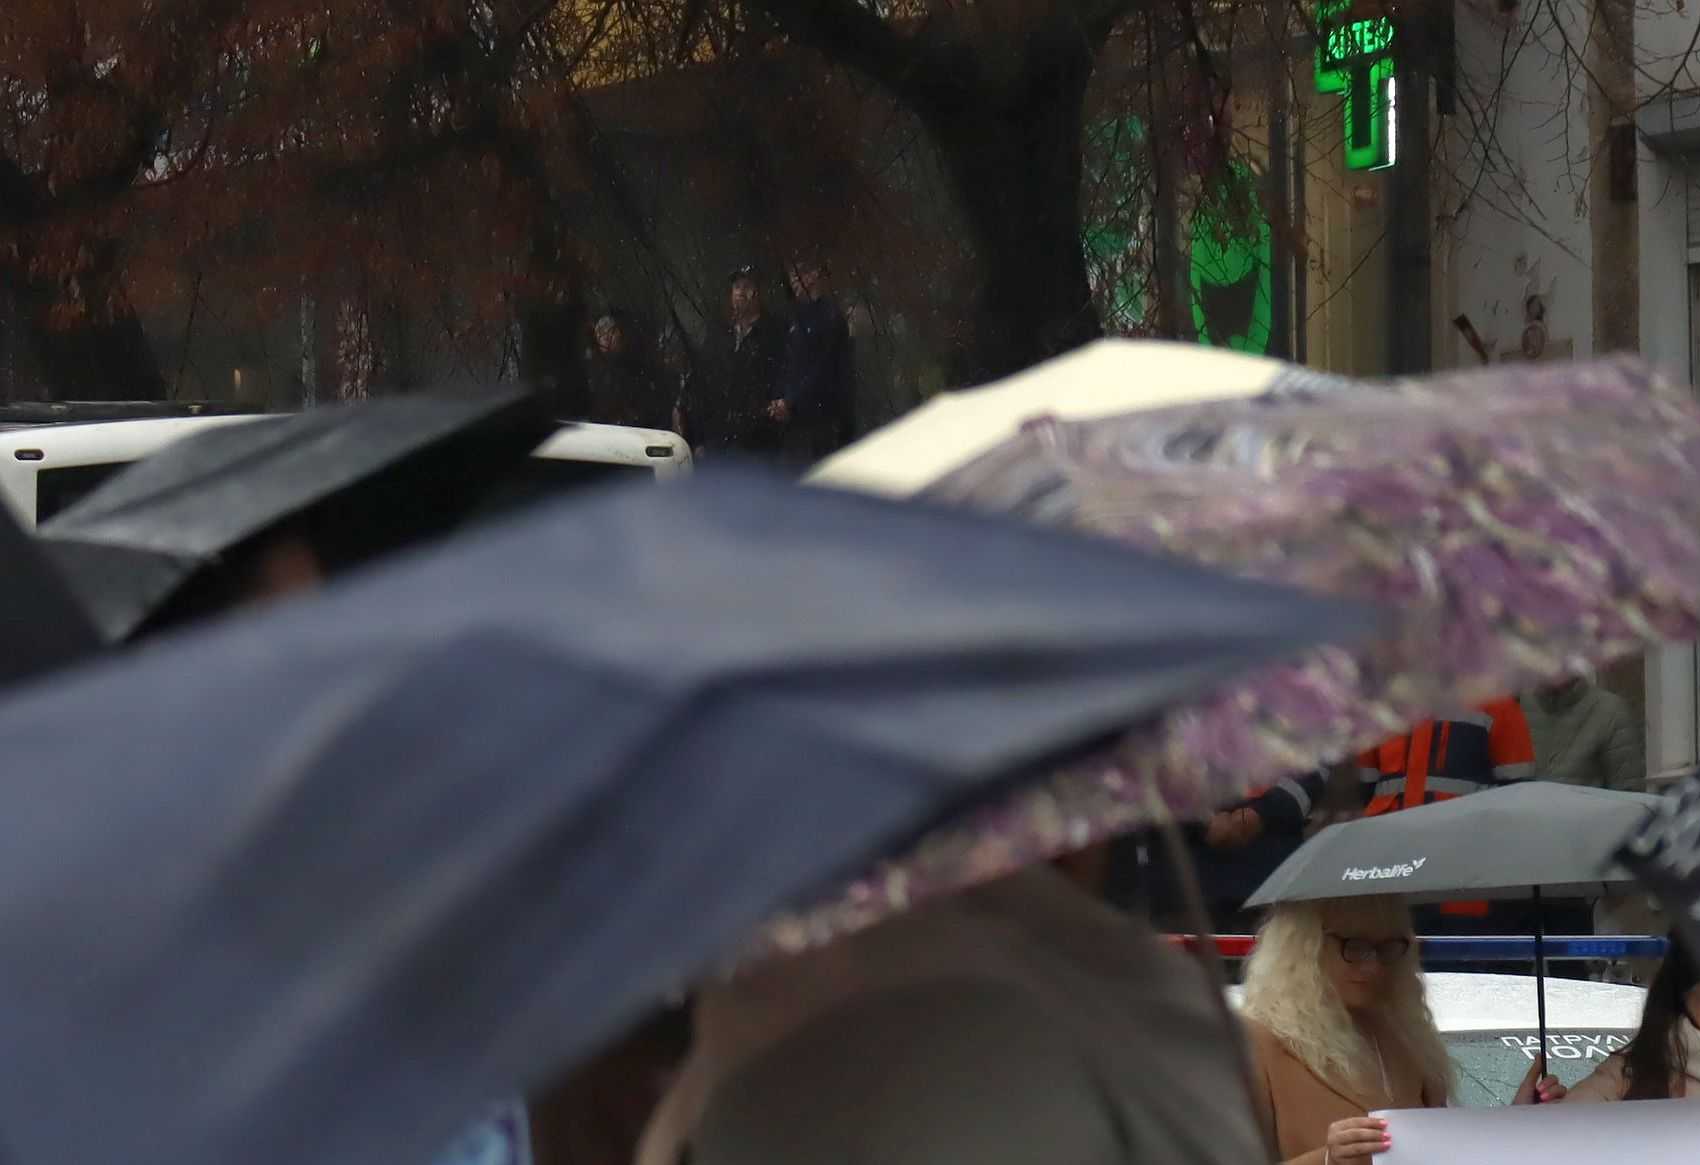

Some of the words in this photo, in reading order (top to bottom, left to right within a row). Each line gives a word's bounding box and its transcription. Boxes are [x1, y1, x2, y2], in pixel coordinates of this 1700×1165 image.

[1342, 863, 1414, 881] Herbalife
[1501, 1034, 1630, 1047] ПАТРУЛ
[1521, 1045, 1616, 1060] ПОЛ
